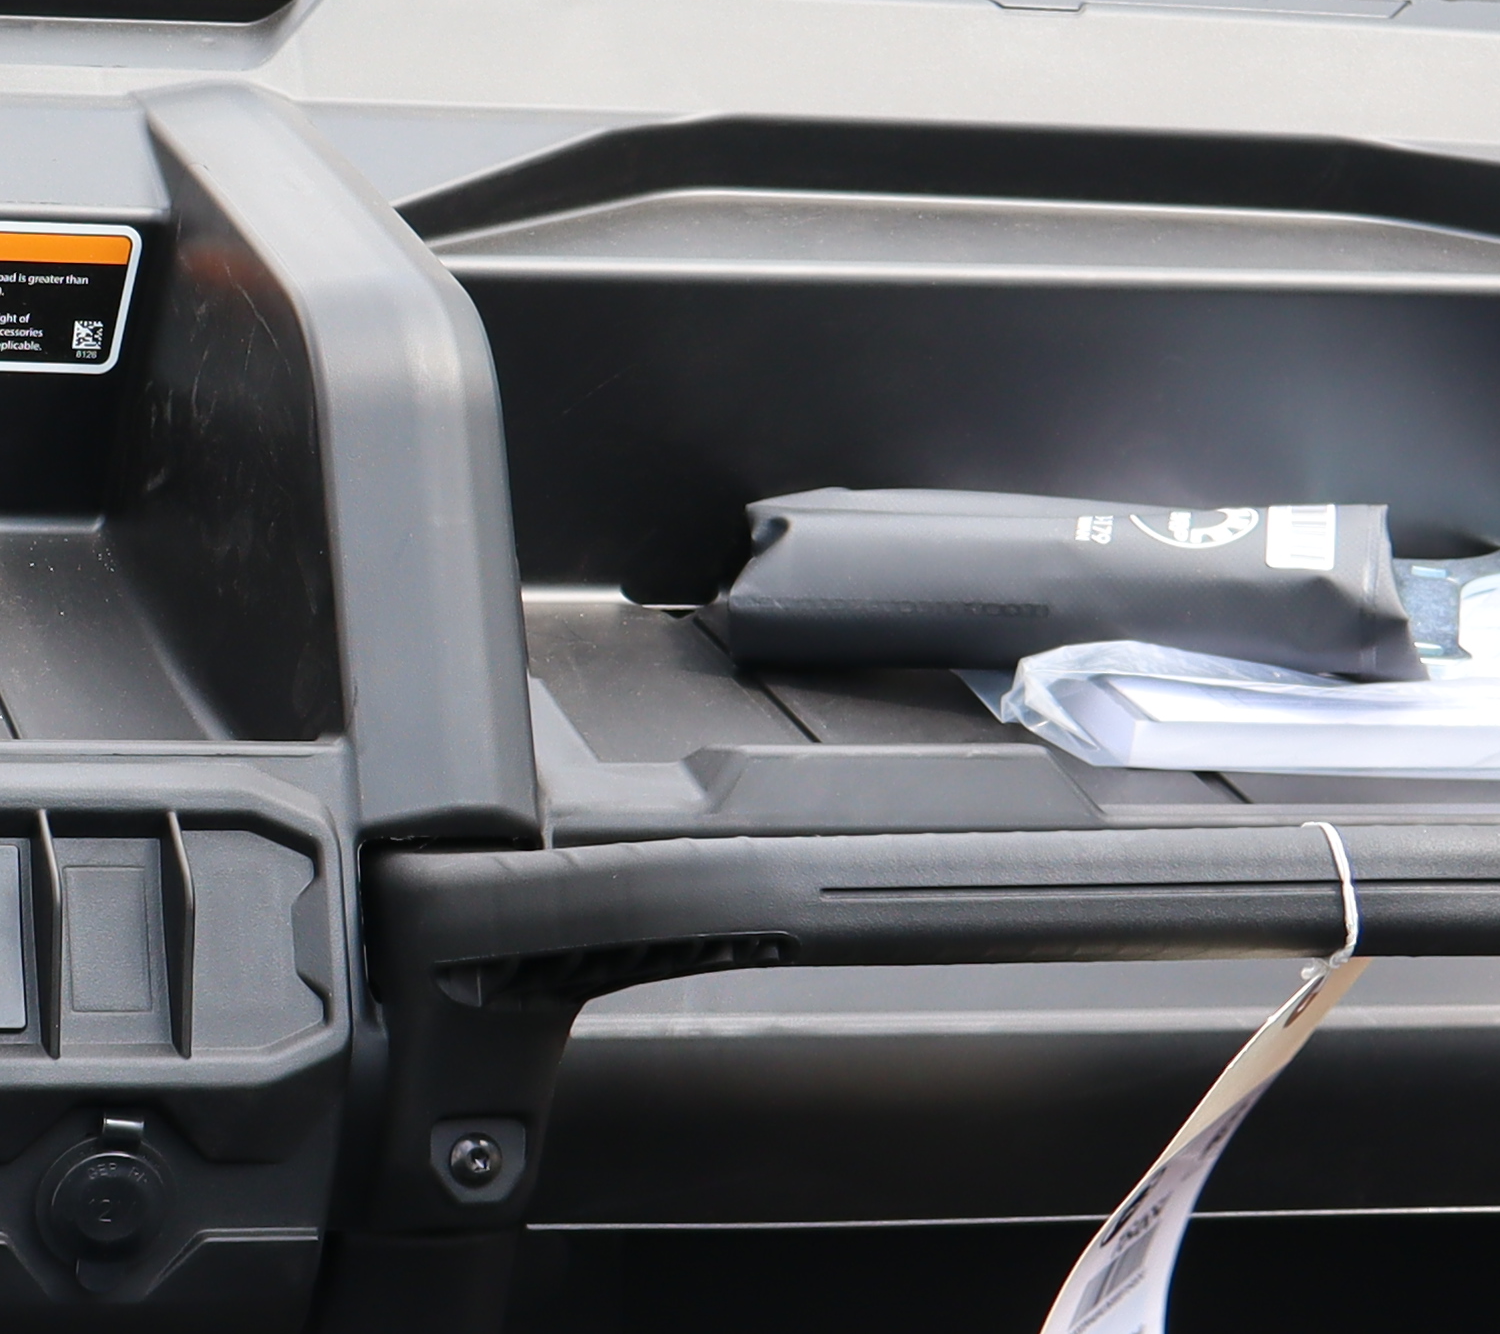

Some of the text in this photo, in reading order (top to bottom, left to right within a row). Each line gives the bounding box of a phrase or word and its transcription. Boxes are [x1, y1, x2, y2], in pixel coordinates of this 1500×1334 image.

[18, 272, 26, 283] is
[27, 274, 65, 285] greater
[65, 274, 89, 285] than
[18, 313, 30, 323] of
